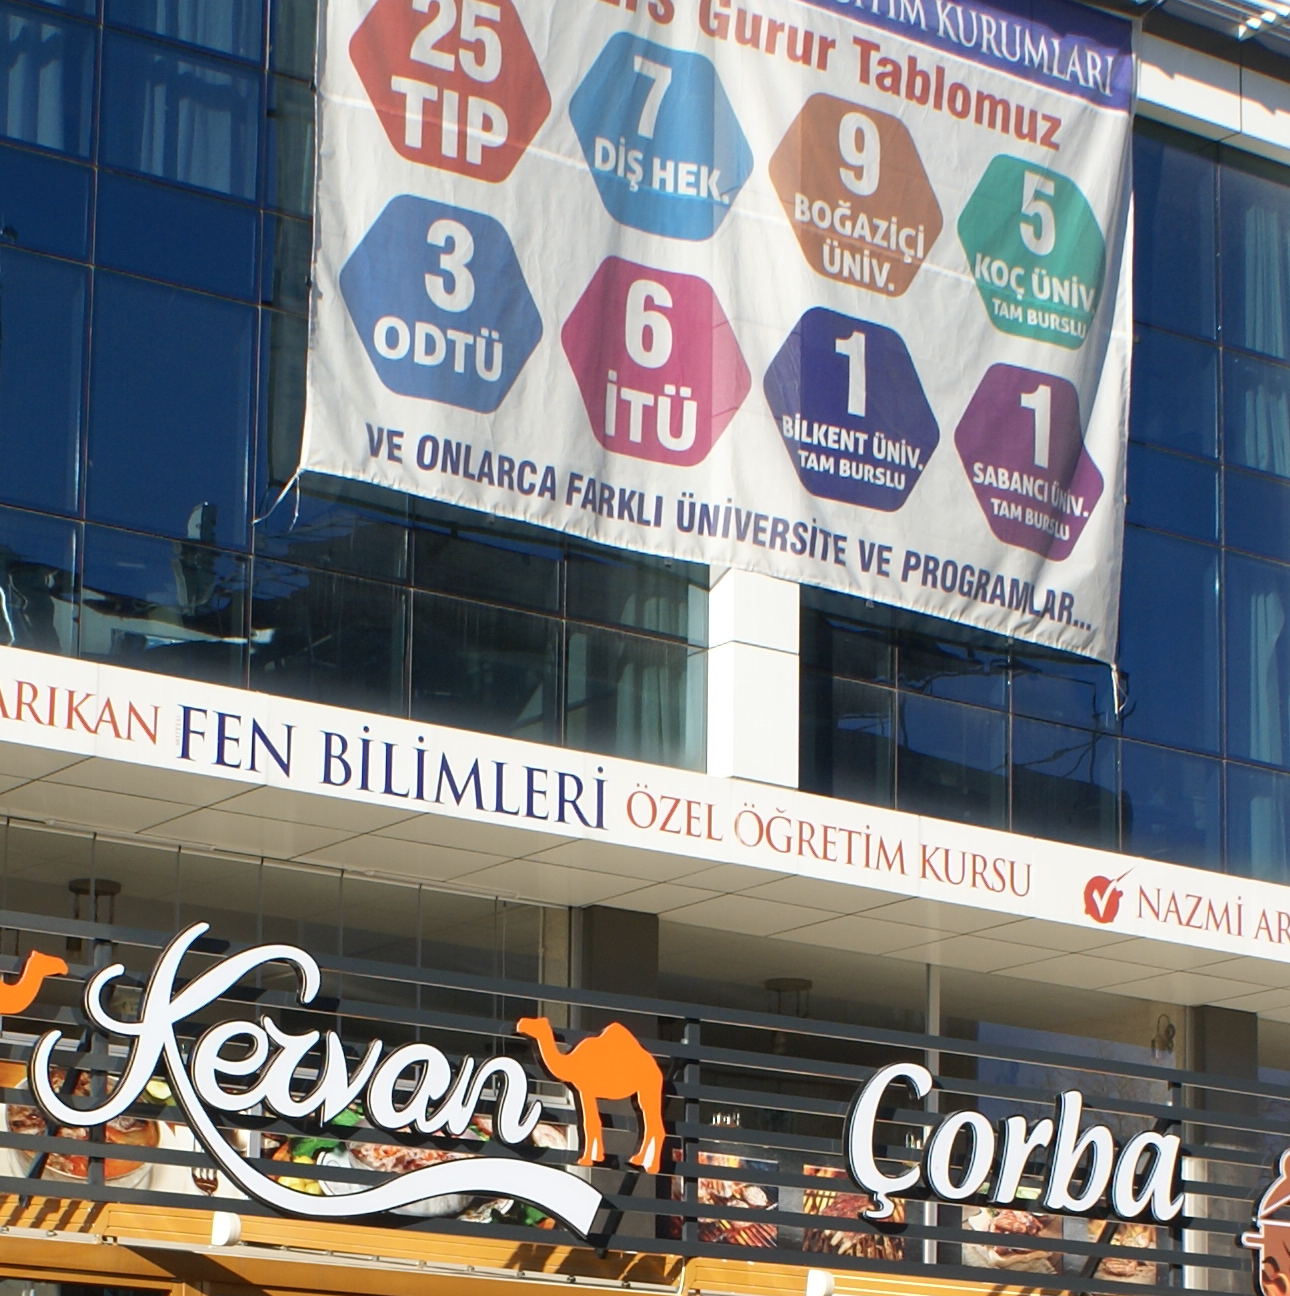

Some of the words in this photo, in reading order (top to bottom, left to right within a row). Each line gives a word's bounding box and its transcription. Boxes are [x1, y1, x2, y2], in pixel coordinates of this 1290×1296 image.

[410, 0, 502, 83] 25
[699, 0, 836, 71] Gurur
[851, 36, 1063, 151] Tablomuz
[936, 0, 1116, 97] KURUMLARI
[390, 75, 509, 165] TIP
[633, 55, 672, 140] 7
[595, 137, 642, 191] DİŞ
[653, 159, 730, 205] HEK.
[838, 112, 880, 196] 9
[794, 193, 925, 262] BOĞAZİÇİ
[1020, 170, 1056, 256] 5
[425, 219, 475, 313] 3
[822, 239, 895, 292] ÜNİV.
[975, 252, 1025, 298] KOÇ
[1032, 268, 1095, 314] ÜNİV.
[374, 316, 503, 382] ODTÜ
[625, 279, 673, 369] 6
[992, 298, 1022, 323] TAM
[1027, 310, 1086, 338] BURSLU
[605, 369, 698, 452] İTÜ
[835, 331, 866, 417] 1
[782, 414, 868, 456] BİLKENT
[873, 432, 924, 472] ÜNİV.
[1021, 384, 1051, 469] 1
[798, 448, 835, 474] TAM
[839, 460, 906, 491] BURSLU
[973, 461, 1048, 502] SABANCI
[1051, 480, 1090, 518] ÜNİV.
[365, 422, 404, 464] VE
[416, 434, 556, 501] ONLARCA
[566, 472, 663, 528] FARKLI
[676, 491, 847, 566] ÜNİVERSİTE
[859, 540, 893, 578] VE
[901, 549, 1092, 631] PROGRAMLAR...
[990, 498, 1021, 522] TAM
[1025, 508, 1070, 542] BURSLU
[176, 704, 297, 779] FEN
[320, 725, 609, 832] BİLİMLERİ
[627, 782, 723, 842] ÖZEL
[735, 800, 908, 876] ÖĞRETİM
[919, 844, 1034, 898] KURSU
[1138, 884, 1244, 937] NAZMİ
[30, 921, 603, 1239] Kervan
[845, 1061, 1184, 1222] Çorba
